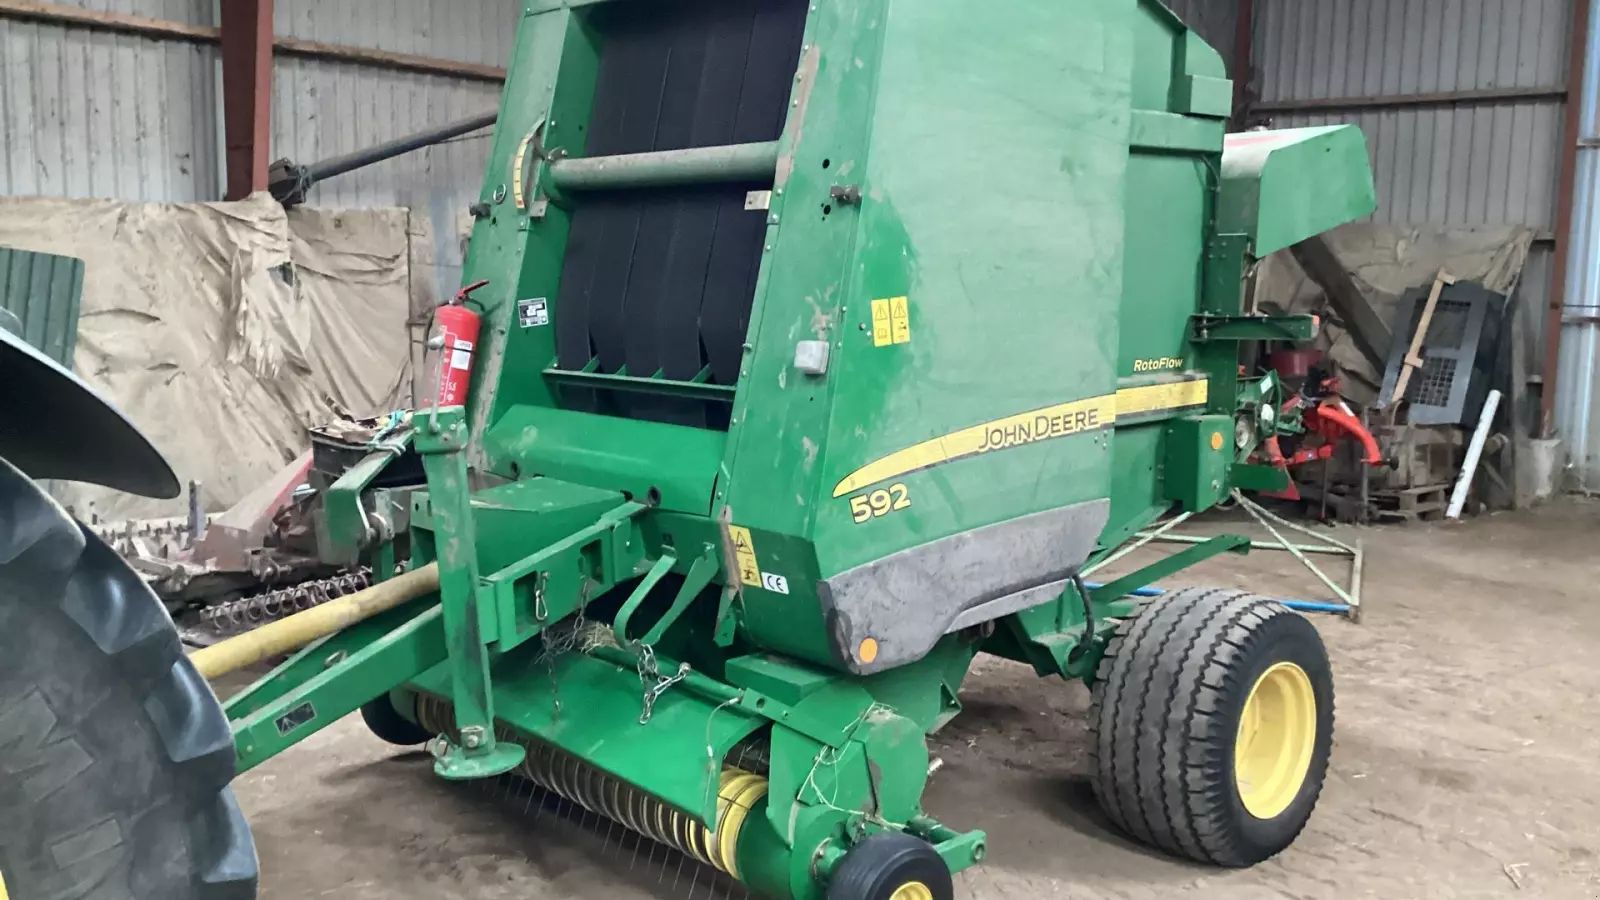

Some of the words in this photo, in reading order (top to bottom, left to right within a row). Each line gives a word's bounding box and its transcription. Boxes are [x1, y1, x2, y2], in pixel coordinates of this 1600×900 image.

[1133, 357, 1184, 372] RotoFlow
[978, 421, 1031, 450] JOHN
[1035, 408, 1099, 438] DEERE
[849, 482, 912, 524] 592
[767, 575, 785, 592] CE
